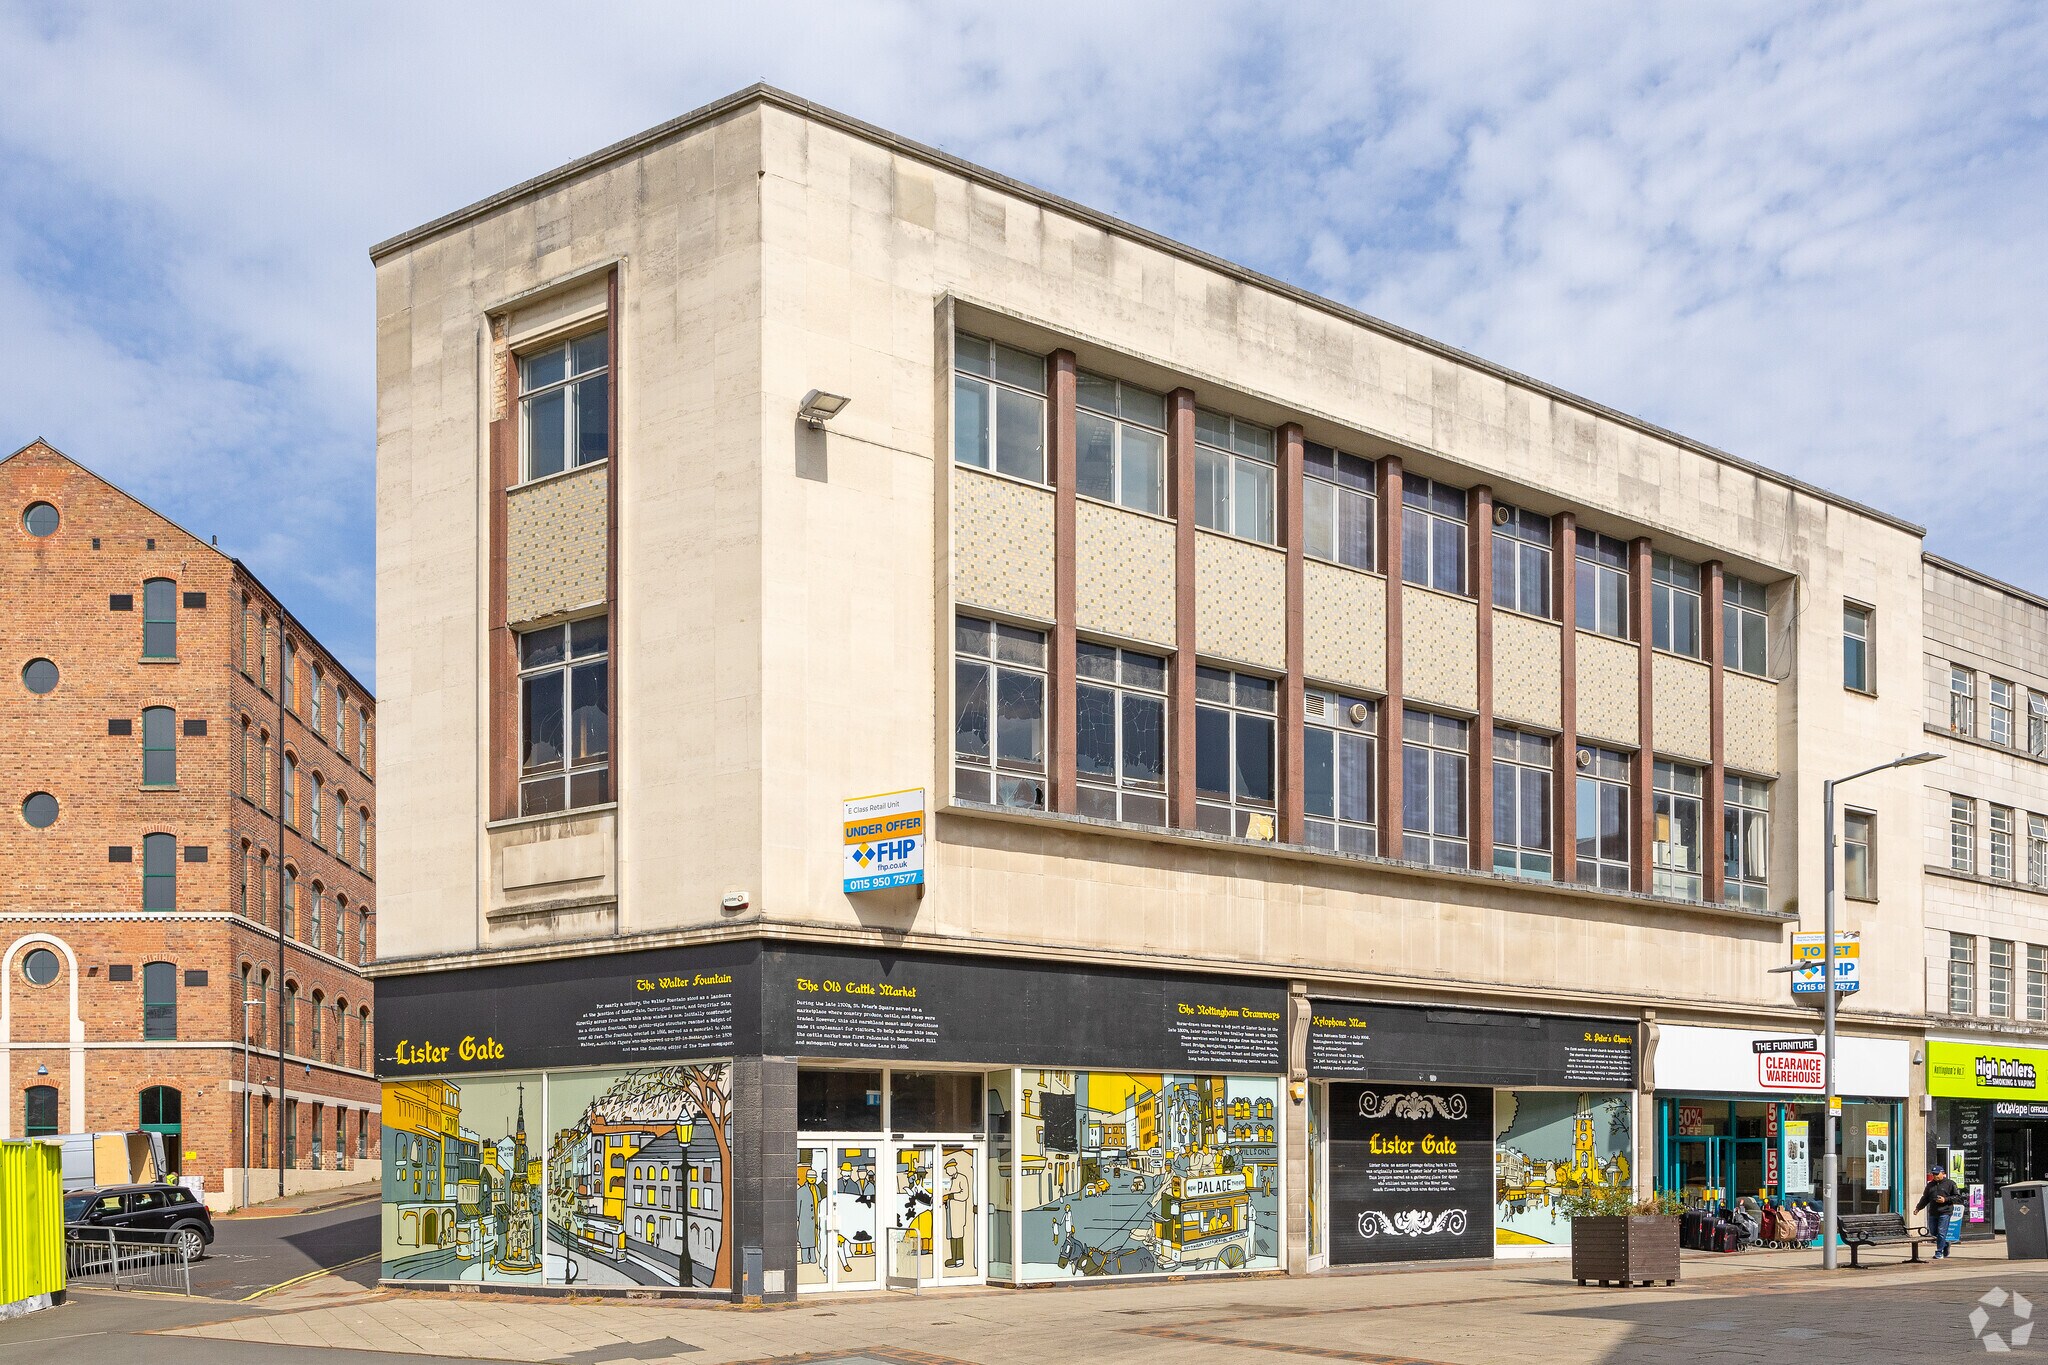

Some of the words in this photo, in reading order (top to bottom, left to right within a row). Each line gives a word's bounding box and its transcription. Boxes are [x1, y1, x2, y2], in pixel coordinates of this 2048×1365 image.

[846, 824, 882, 837] UNDER
[886, 818, 920, 832] OFFER
[878, 839, 916, 862] FHP
[878, 861, 907, 872] fhp.co.uk
[850, 880, 870, 890] 0115
[873, 877, 890, 888] 950
[893, 873, 917, 884] 7577
[1802, 946, 1821, 956] TO
[1834, 946, 1851, 955] ET
[636, 980, 655, 992] The
[658, 976, 689, 989] Walter
[692, 974, 732, 986] Fountain
[797, 978, 819, 993] The
[823, 980, 841, 992] Old
[846, 982, 875, 994] Cattle
[879, 983, 917, 997] Market
[1178, 1004, 1194, 1015] The
[1197, 1005, 1239, 1018] Nottingham
[1242, 1008, 1280, 1020] Tramways
[1313, 1016, 1346, 1028] Xylophone
[1349, 1018, 1366, 1028] Man
[1613, 1035, 1632, 1044] Church
[1756, 1043, 1771, 1051] THE
[1773, 1041, 1814, 1050] FURNITURE
[396, 1040, 450, 1064] Lister
[459, 1036, 505, 1061] Gate
[1766, 1056, 1821, 1071] CLEARANCE
[1976, 1057, 1998, 1079] High
[2000, 1061, 2036, 1078] Rollers.
[1766, 1070, 1820, 1083] WAREHOUSE
[1992, 1078, 2013, 1086] SMOKING
[1679, 1109, 1701, 1127] 50%
[1369, 1133, 1415, 1154] Lister
[1422, 1133, 1457, 1154] Gate
[1197, 1179, 1231, 1193] PALACE
